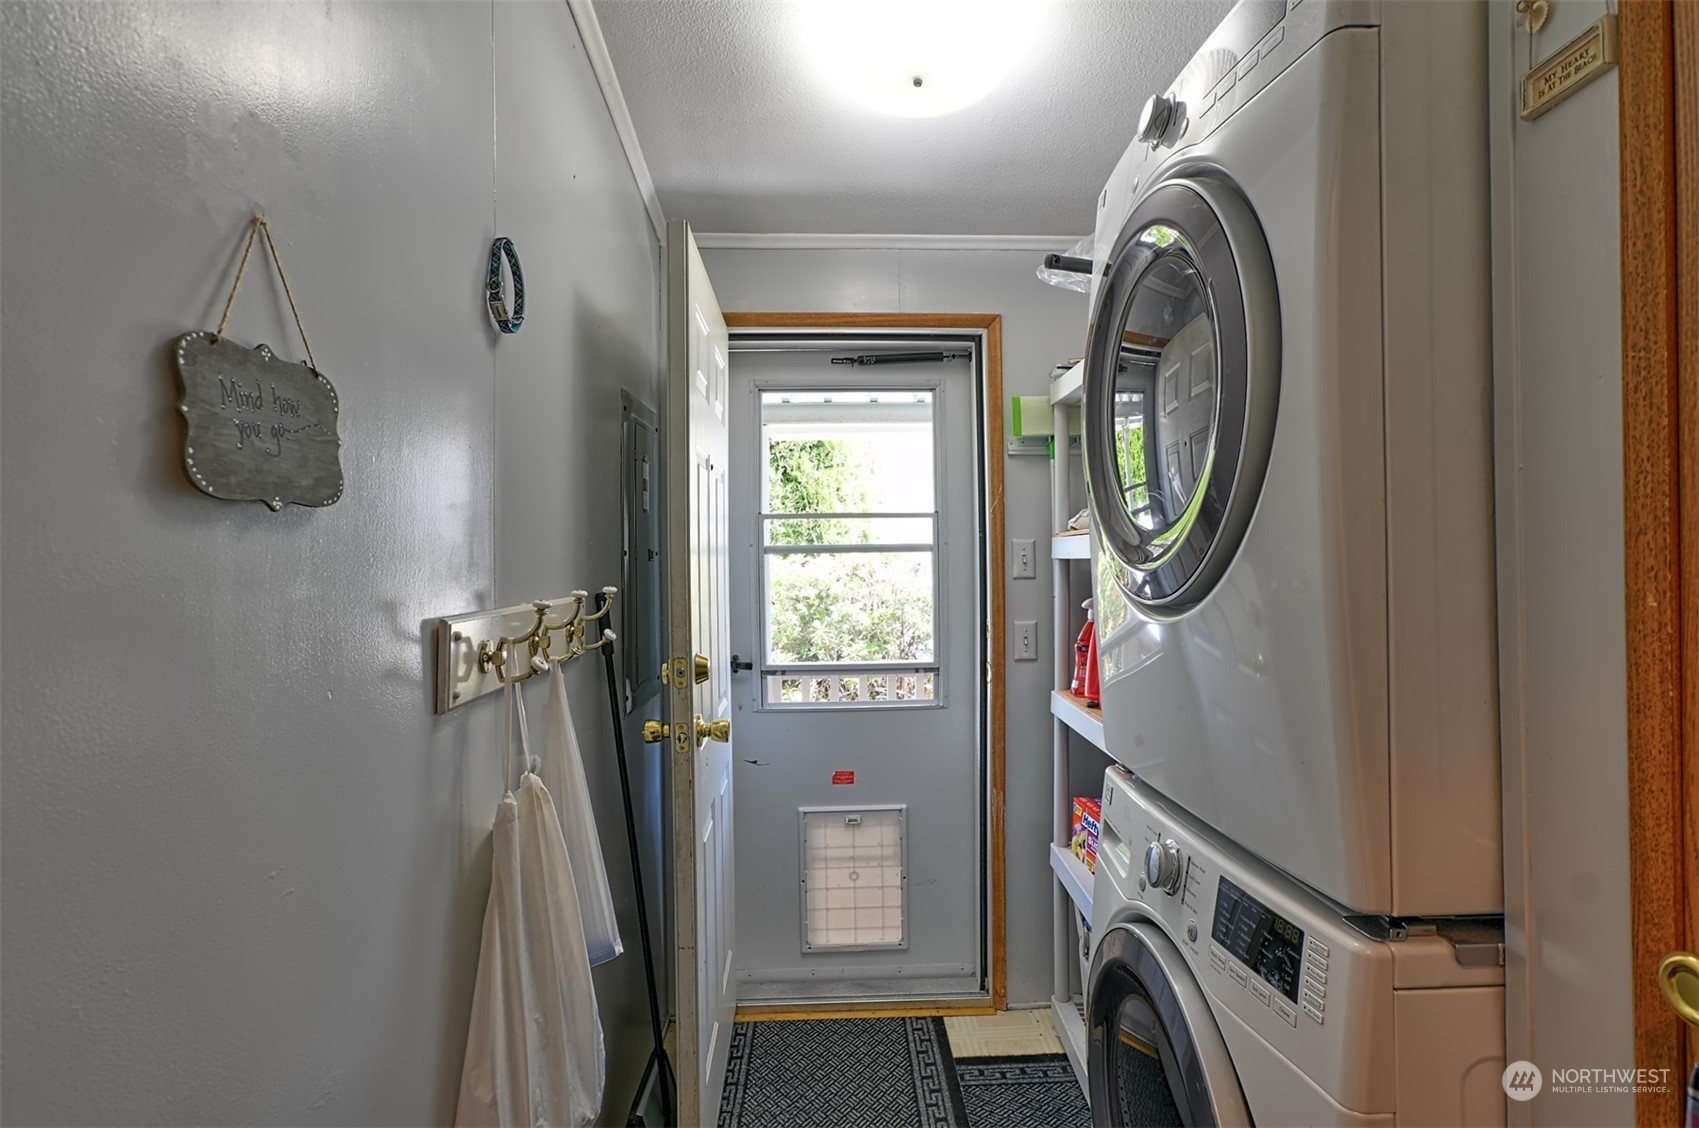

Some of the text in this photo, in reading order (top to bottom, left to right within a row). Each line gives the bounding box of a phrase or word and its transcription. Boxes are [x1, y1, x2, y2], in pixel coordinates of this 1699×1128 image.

[1538, 53, 1597, 99] IS AT THE BEACH
[1544, 48, 1590, 86] MY HEART
[218, 375, 301, 418] Mind how
[233, 418, 262, 450] you
